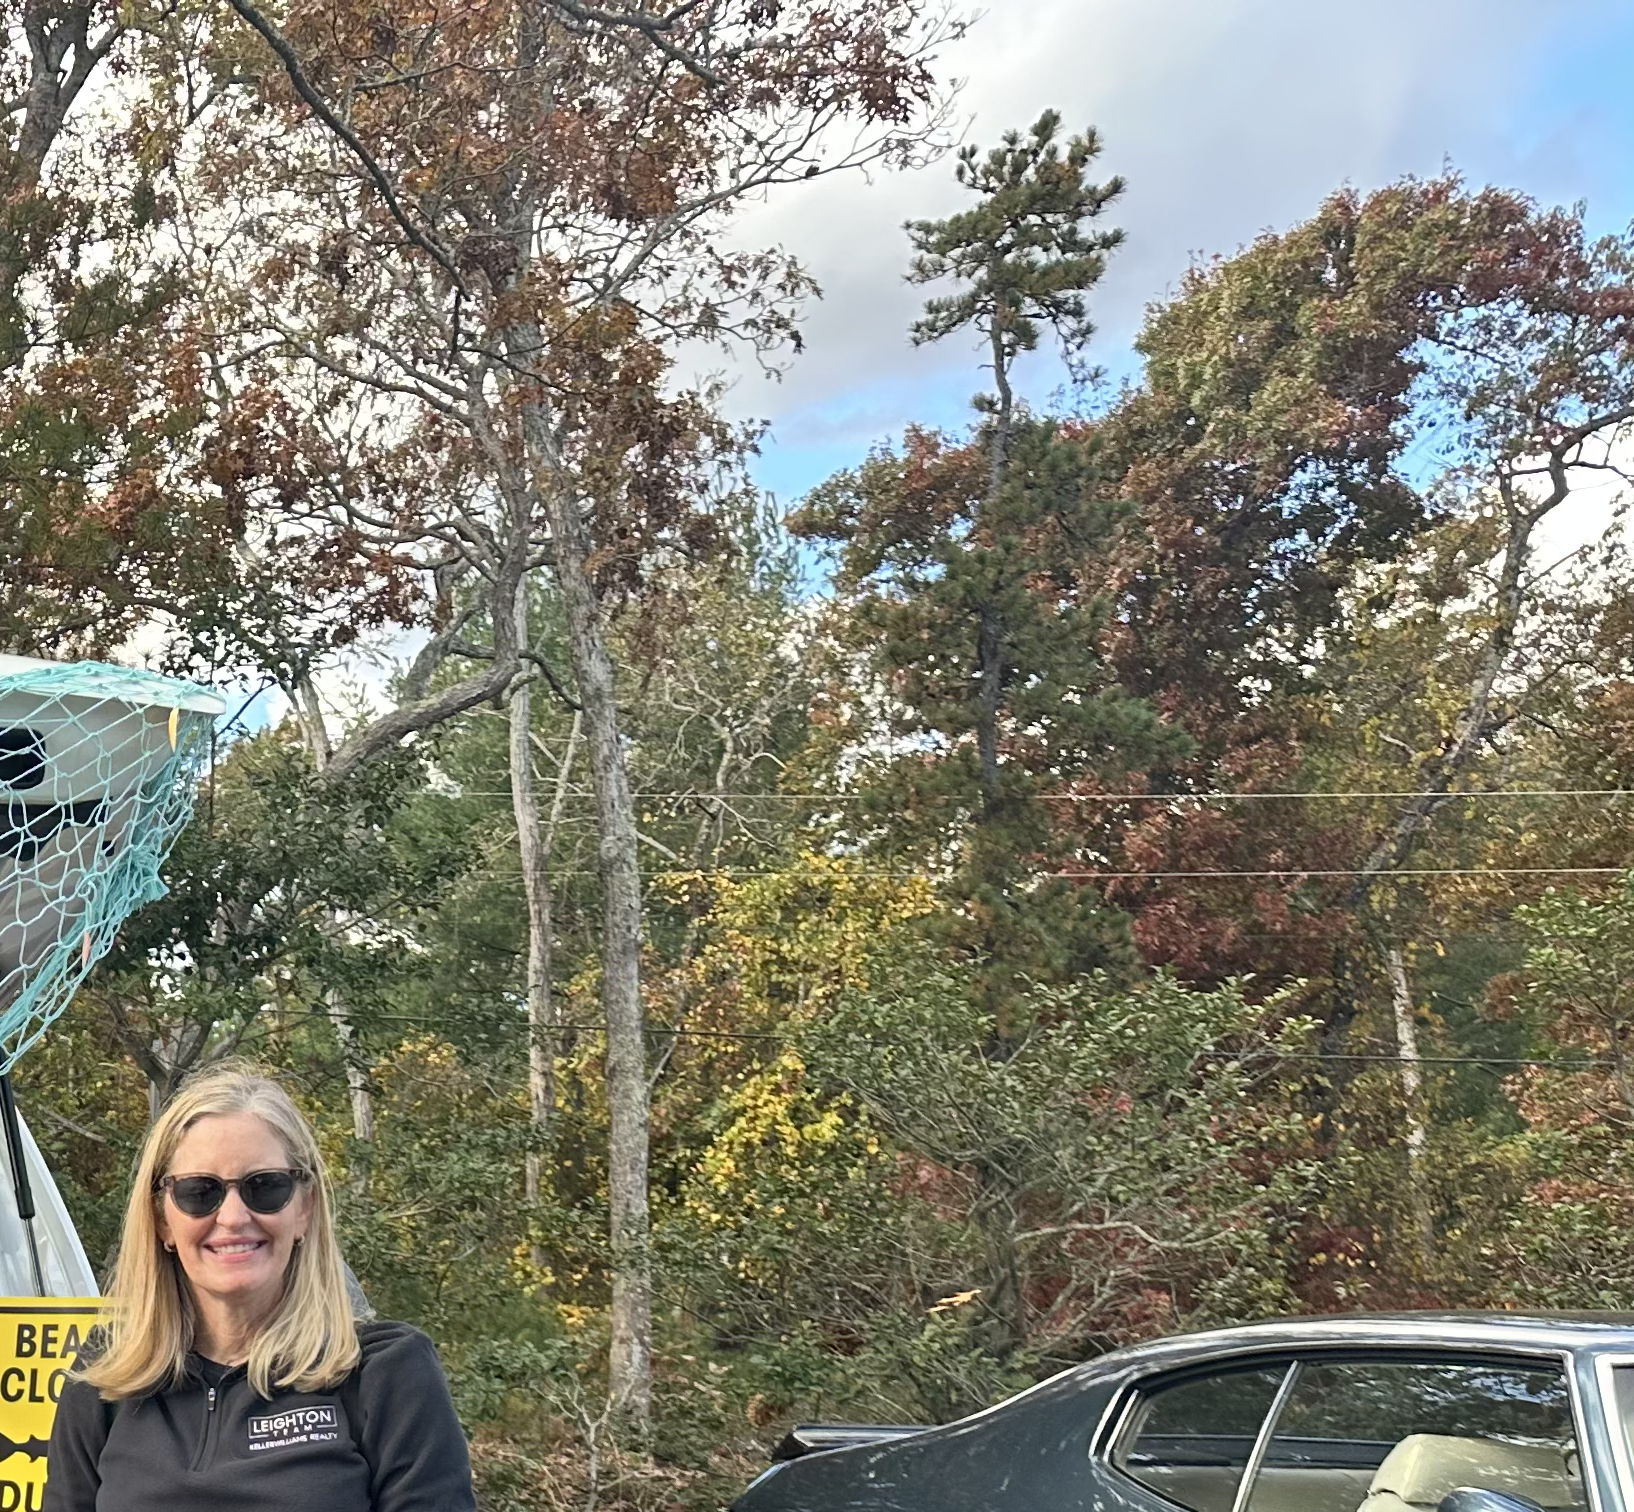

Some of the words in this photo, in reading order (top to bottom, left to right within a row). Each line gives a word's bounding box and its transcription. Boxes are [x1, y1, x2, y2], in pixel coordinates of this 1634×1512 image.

[0, 1367, 66, 1403] CLO
[253, 1410, 332, 1433] LEIGHTON
[272, 1424, 313, 1437] TEAM
